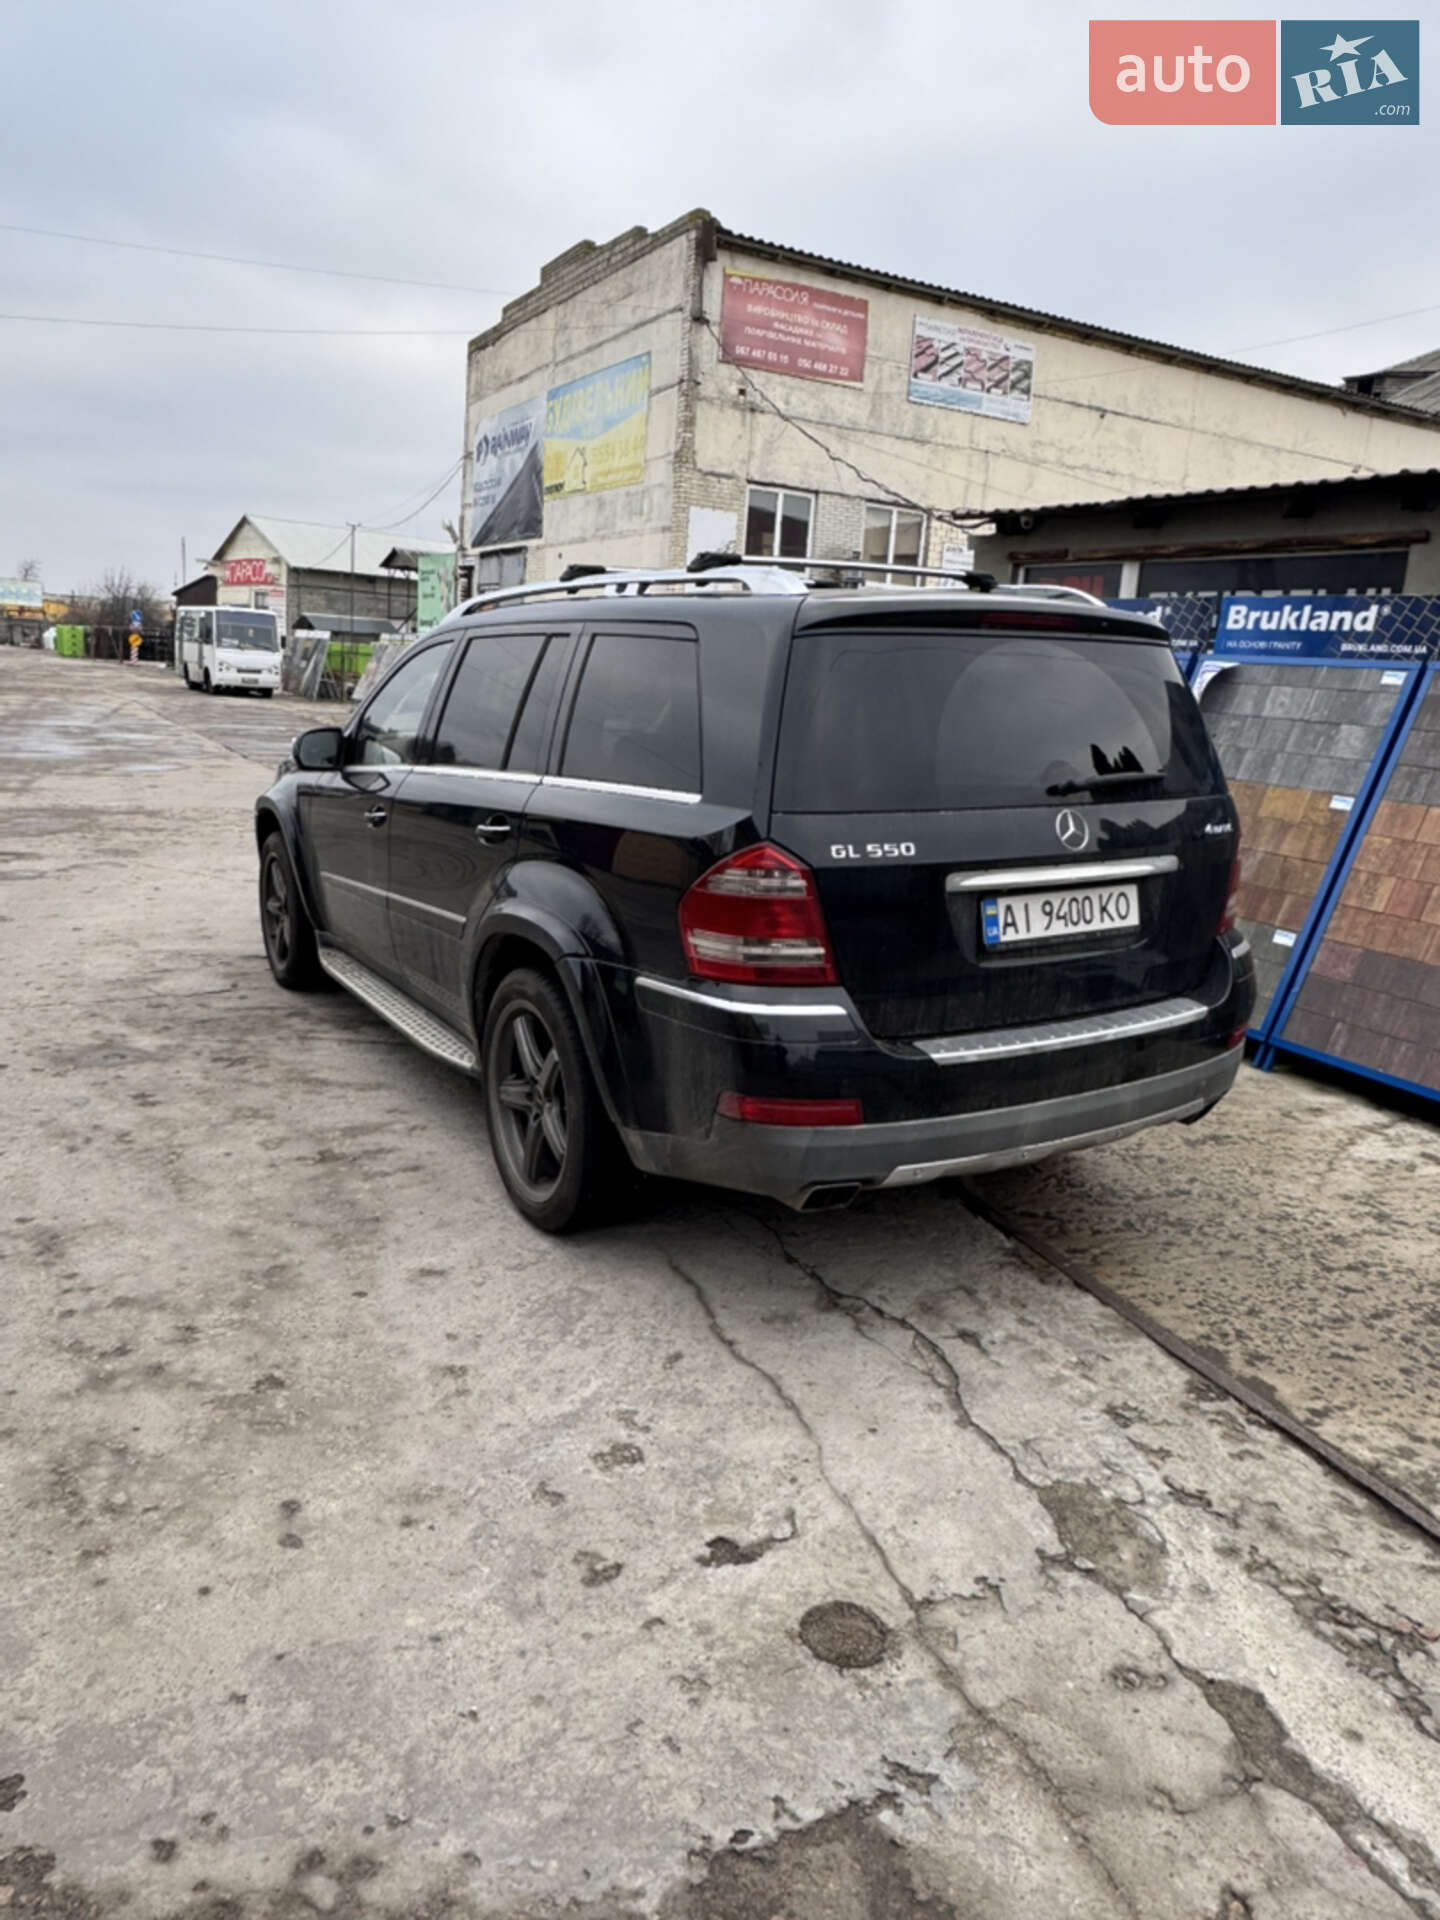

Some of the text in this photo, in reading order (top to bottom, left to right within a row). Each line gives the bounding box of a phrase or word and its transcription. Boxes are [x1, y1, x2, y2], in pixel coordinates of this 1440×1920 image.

[1225, 605, 1378, 633] Brukland
[830, 842, 916, 860] GL 550
[1041, 895, 1094, 931] 9400
[1099, 892, 1130, 923] KO
